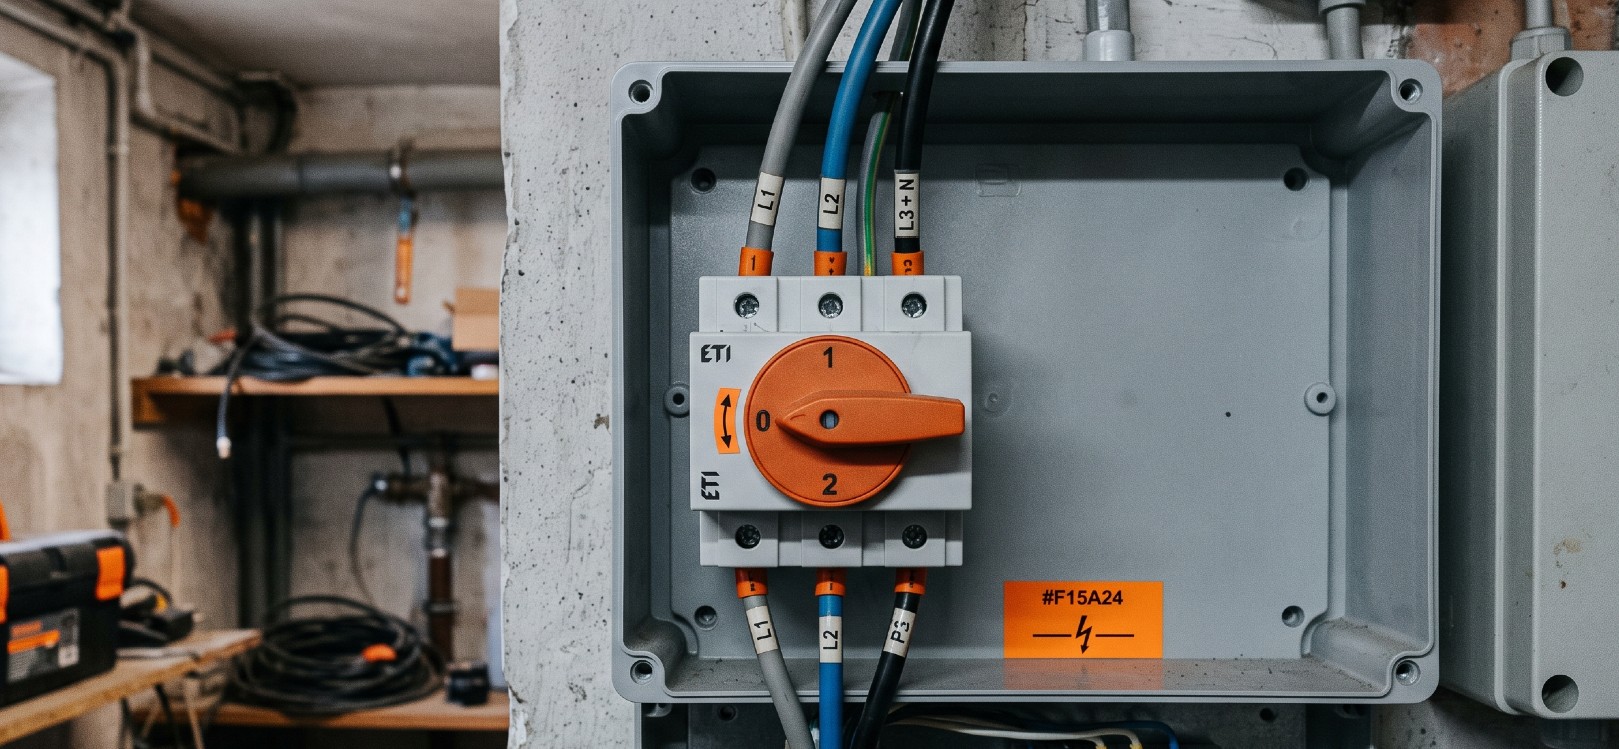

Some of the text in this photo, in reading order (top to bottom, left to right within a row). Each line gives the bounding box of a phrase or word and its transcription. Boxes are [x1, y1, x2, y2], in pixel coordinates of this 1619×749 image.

[757, 188, 775, 211] L1
[822, 193, 840, 215] L2
[700, 344, 731, 363] ETI
[822, 346, 833, 369] 1
[701, 471, 720, 501] ETI
[822, 472, 838, 496] 2
[1042, 589, 1123, 605] #F15A24
[754, 620, 772, 641] L1
[822, 629, 839, 650] L2
